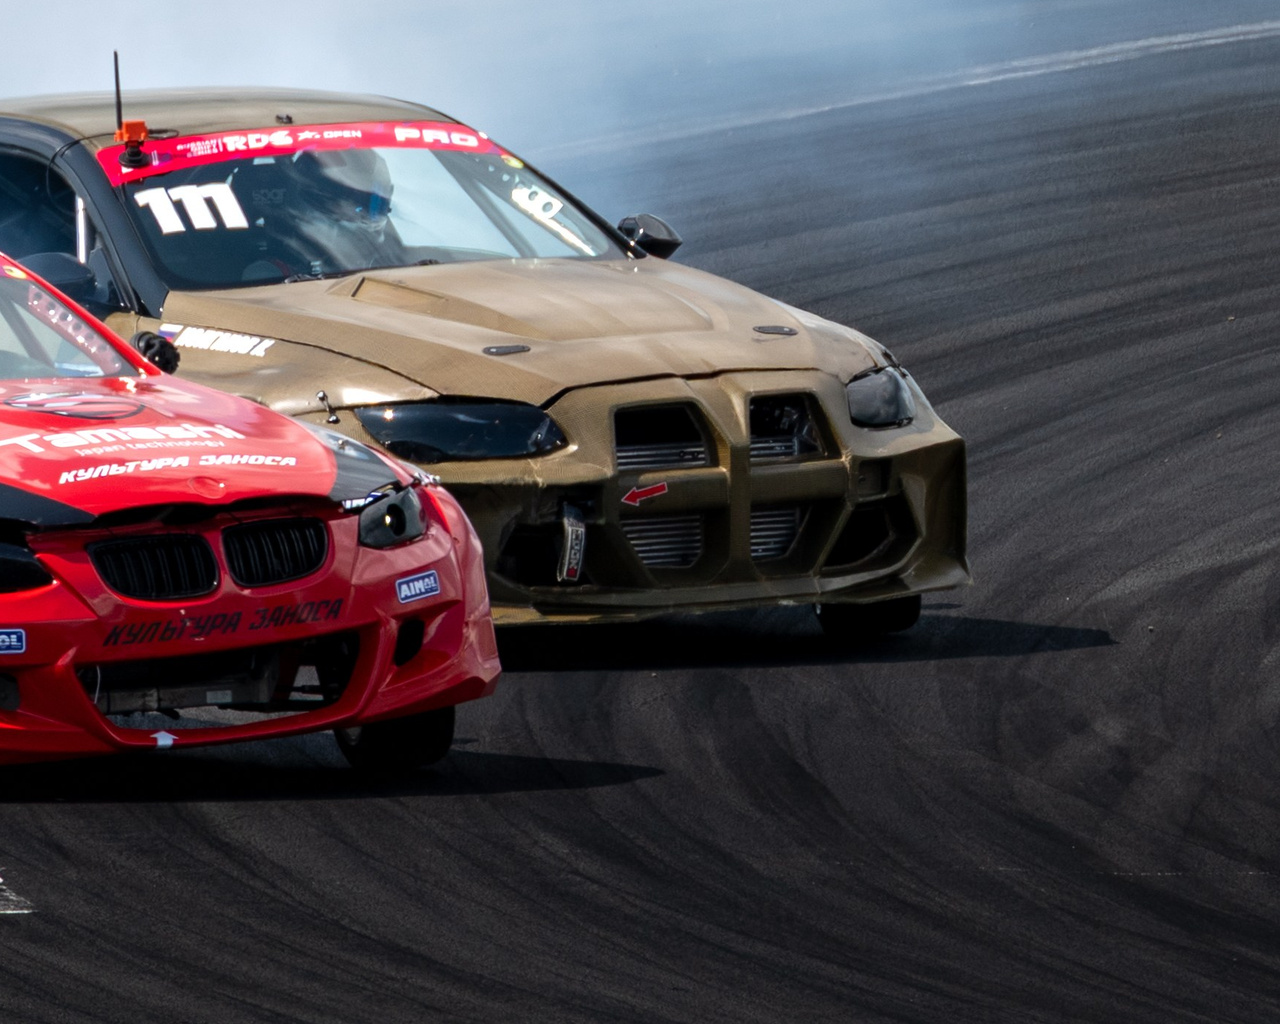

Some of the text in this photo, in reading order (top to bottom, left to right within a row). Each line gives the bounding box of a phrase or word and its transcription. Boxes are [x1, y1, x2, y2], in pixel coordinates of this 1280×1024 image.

[323, 130, 362, 138] OPEN
[394, 127, 479, 147] PRO
[134, 182, 249, 234] 111
[127, 438, 225, 450] technology
[59, 454, 297, 484] КУЛЬТУРА ЗАНОСА
[102, 598, 344, 647] КУЛЬТУРА ЗАНОСА
